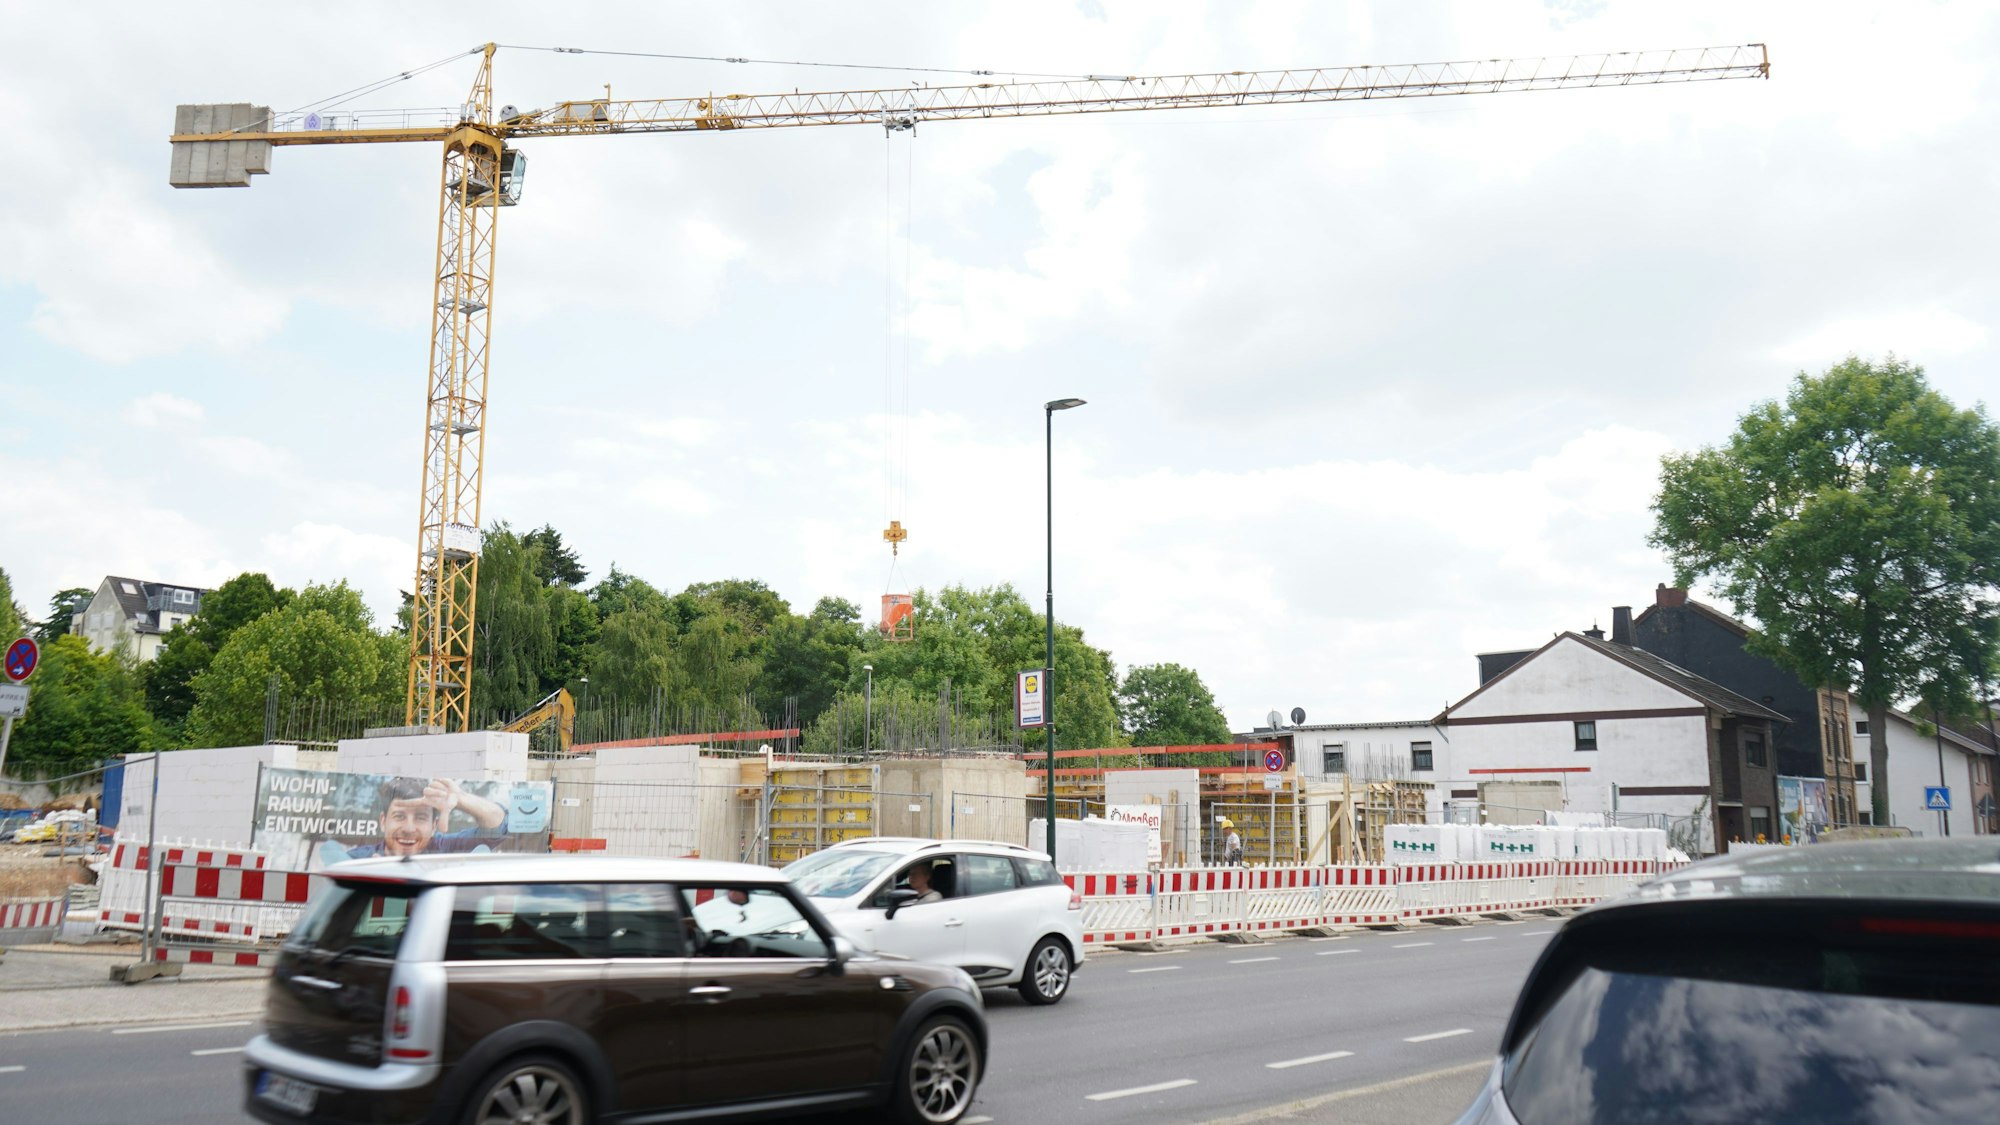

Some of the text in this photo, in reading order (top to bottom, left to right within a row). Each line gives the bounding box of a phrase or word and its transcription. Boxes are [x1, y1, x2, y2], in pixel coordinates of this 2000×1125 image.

[270, 775, 336, 794] WOHN-
[267, 795, 332, 814] RAUM-
[264, 815, 378, 836] ENTWICKLER
[1393, 840, 1435, 851] H+H
[1491, 841, 1533, 852] H+H
